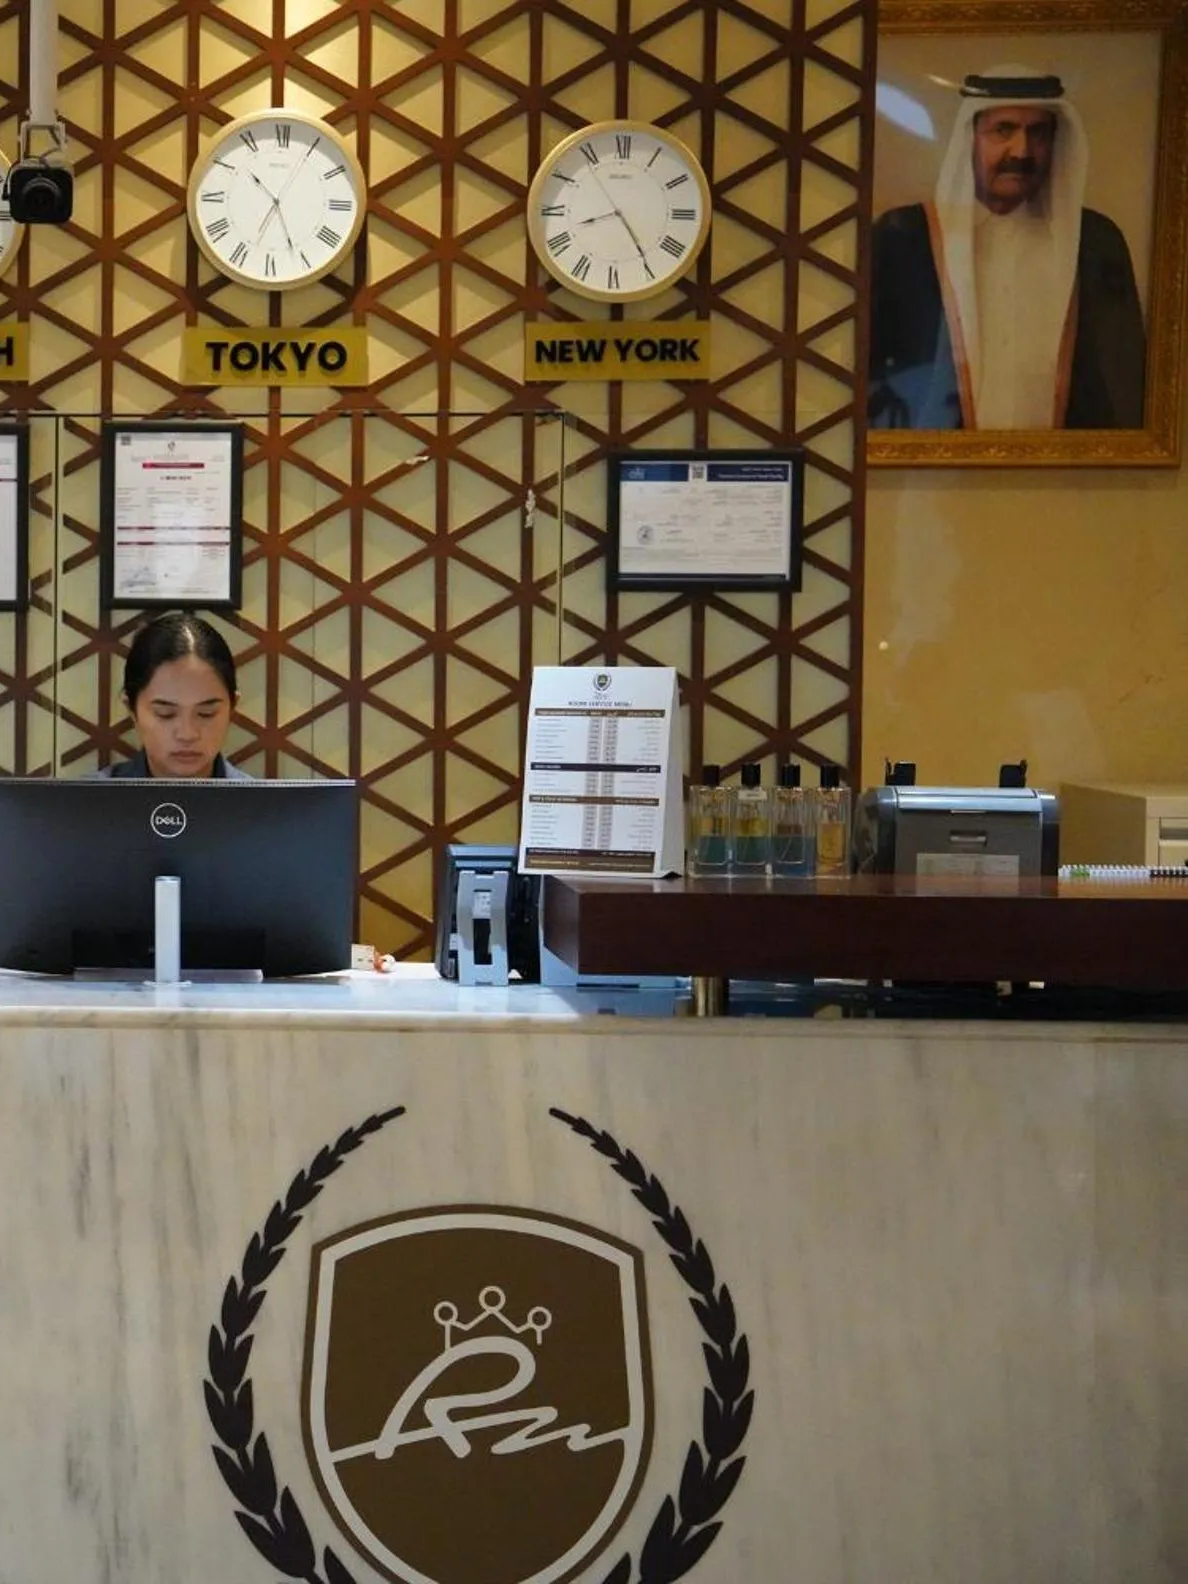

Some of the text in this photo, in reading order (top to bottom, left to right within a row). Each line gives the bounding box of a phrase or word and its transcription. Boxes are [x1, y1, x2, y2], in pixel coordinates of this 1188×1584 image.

[329, 200, 352, 211] III
[672, 209, 696, 220] III
[535, 338, 701, 364] NEW YORK
[206, 341, 347, 373] TOKYO
[155, 815, 182, 825] DELL
